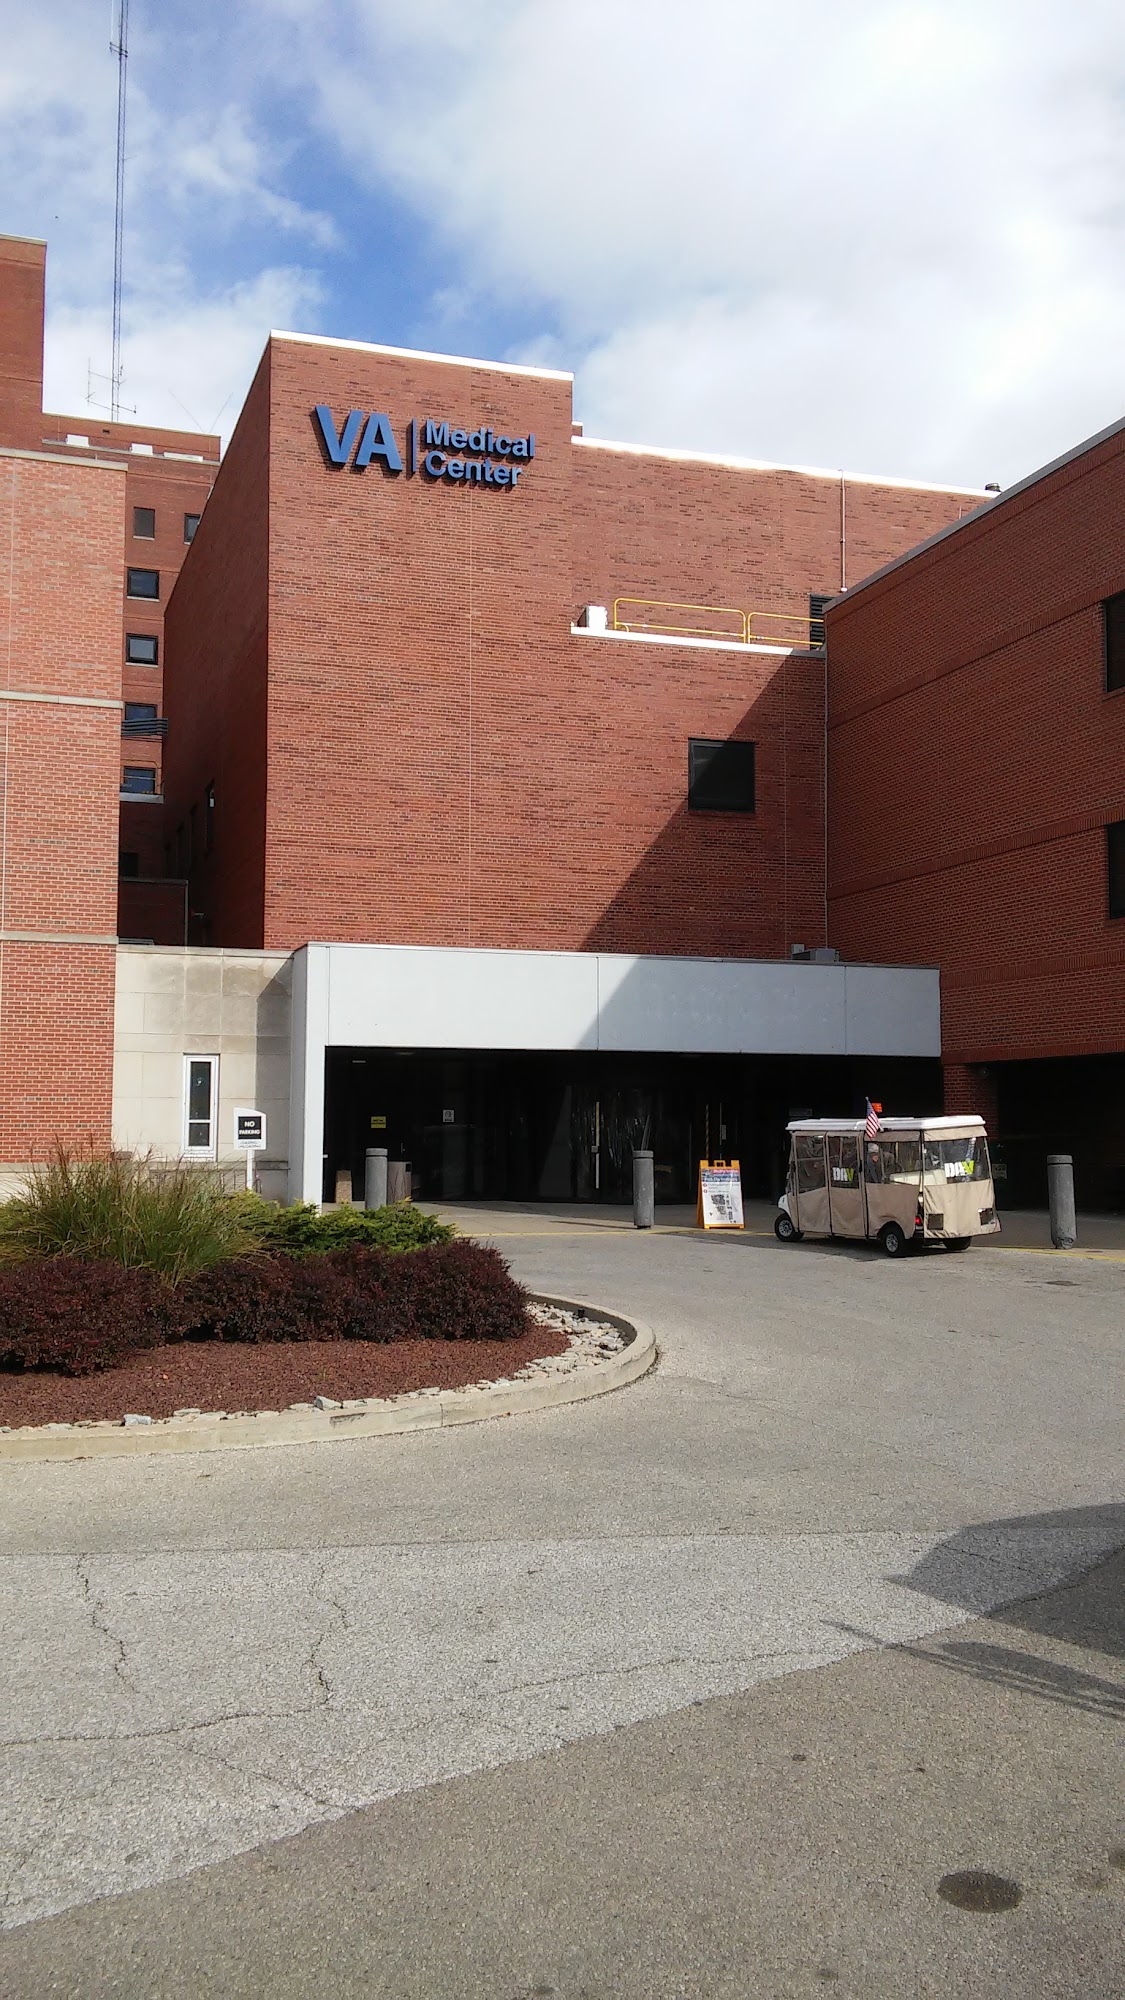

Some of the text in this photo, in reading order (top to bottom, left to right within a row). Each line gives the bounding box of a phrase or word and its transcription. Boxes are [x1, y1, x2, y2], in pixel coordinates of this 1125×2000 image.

[315, 405, 402, 471] VA
[425, 419, 535, 457] Medical
[425, 450, 522, 485] Center
[244, 1120, 256, 1128] NO
[832, 1167, 854, 1181] DAV
[944, 1159, 975, 1177] DAV
